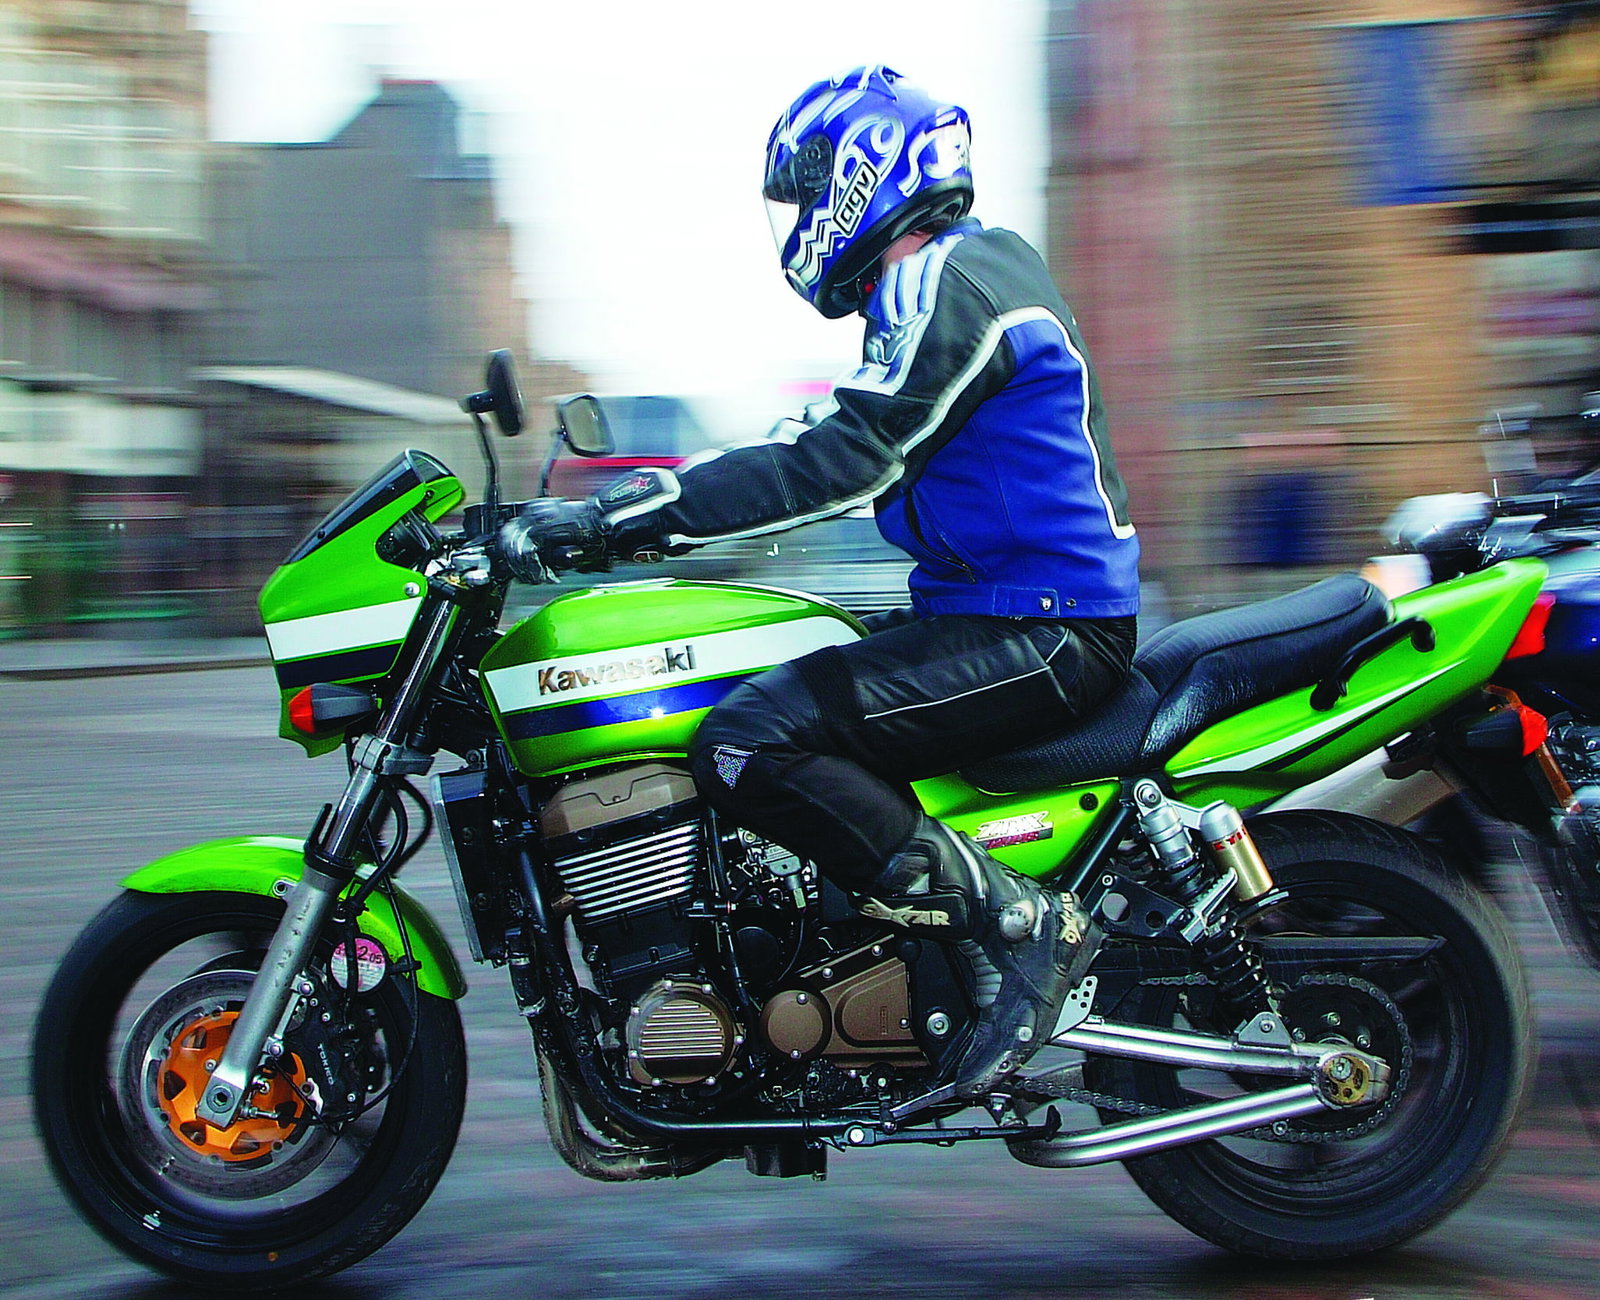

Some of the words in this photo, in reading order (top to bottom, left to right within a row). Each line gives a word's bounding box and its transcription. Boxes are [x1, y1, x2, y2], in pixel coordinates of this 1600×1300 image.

[537, 645, 697, 696] Kawasaki
[355, 946, 368, 960] 2
[369, 952, 383, 964] 05
[318, 1043, 334, 1085] TOKICO
